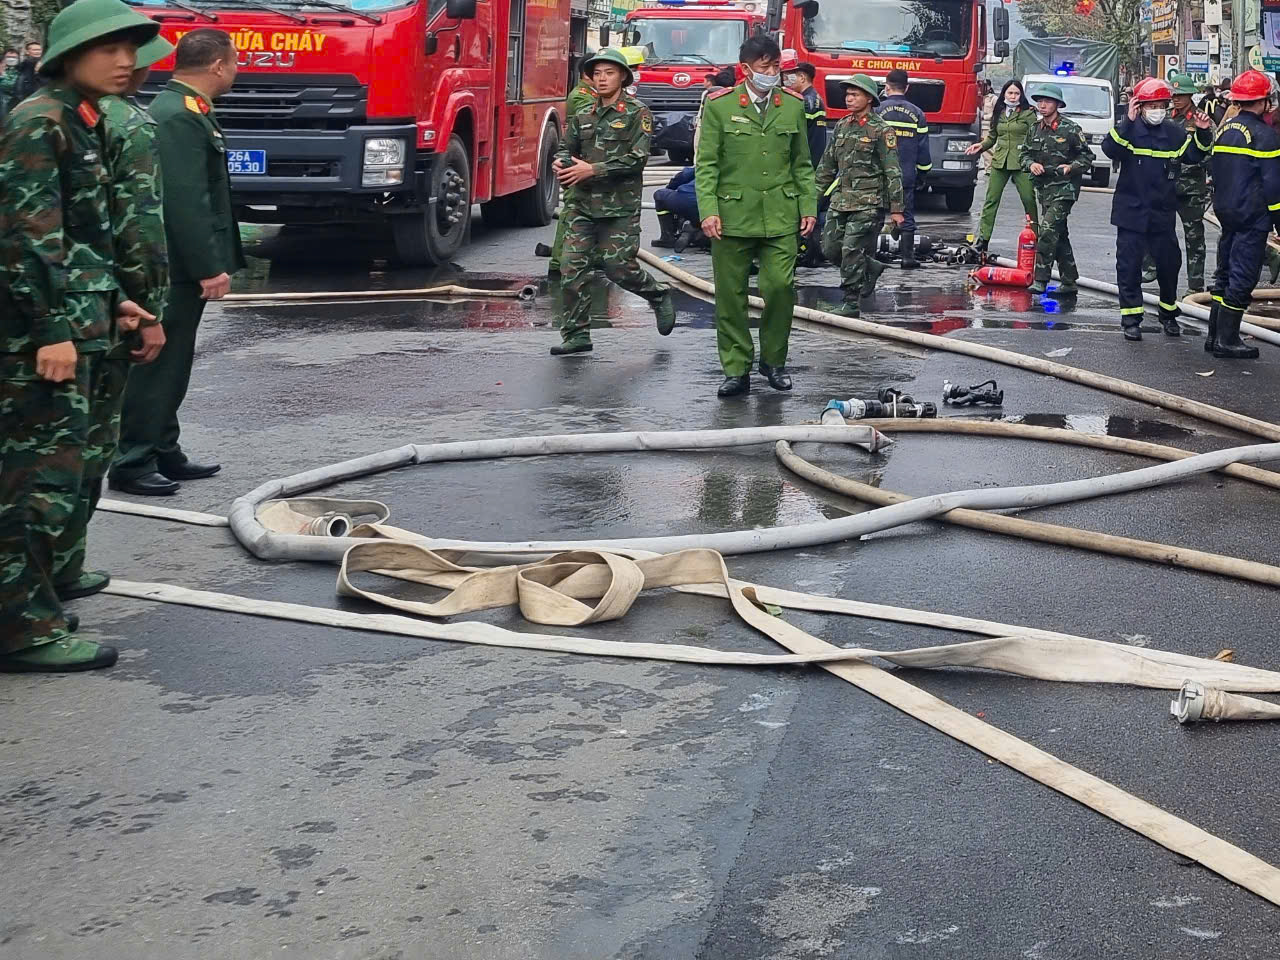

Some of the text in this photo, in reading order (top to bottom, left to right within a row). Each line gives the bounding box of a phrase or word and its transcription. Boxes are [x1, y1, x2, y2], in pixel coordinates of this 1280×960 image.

[271, 30, 328, 51] CHÁY
[236, 52, 295, 67] UZU
[852, 58, 921, 71] XE CHỮA CHÁY
[228, 152, 250, 162] 26A
[228, 162, 259, 172] 05.30
